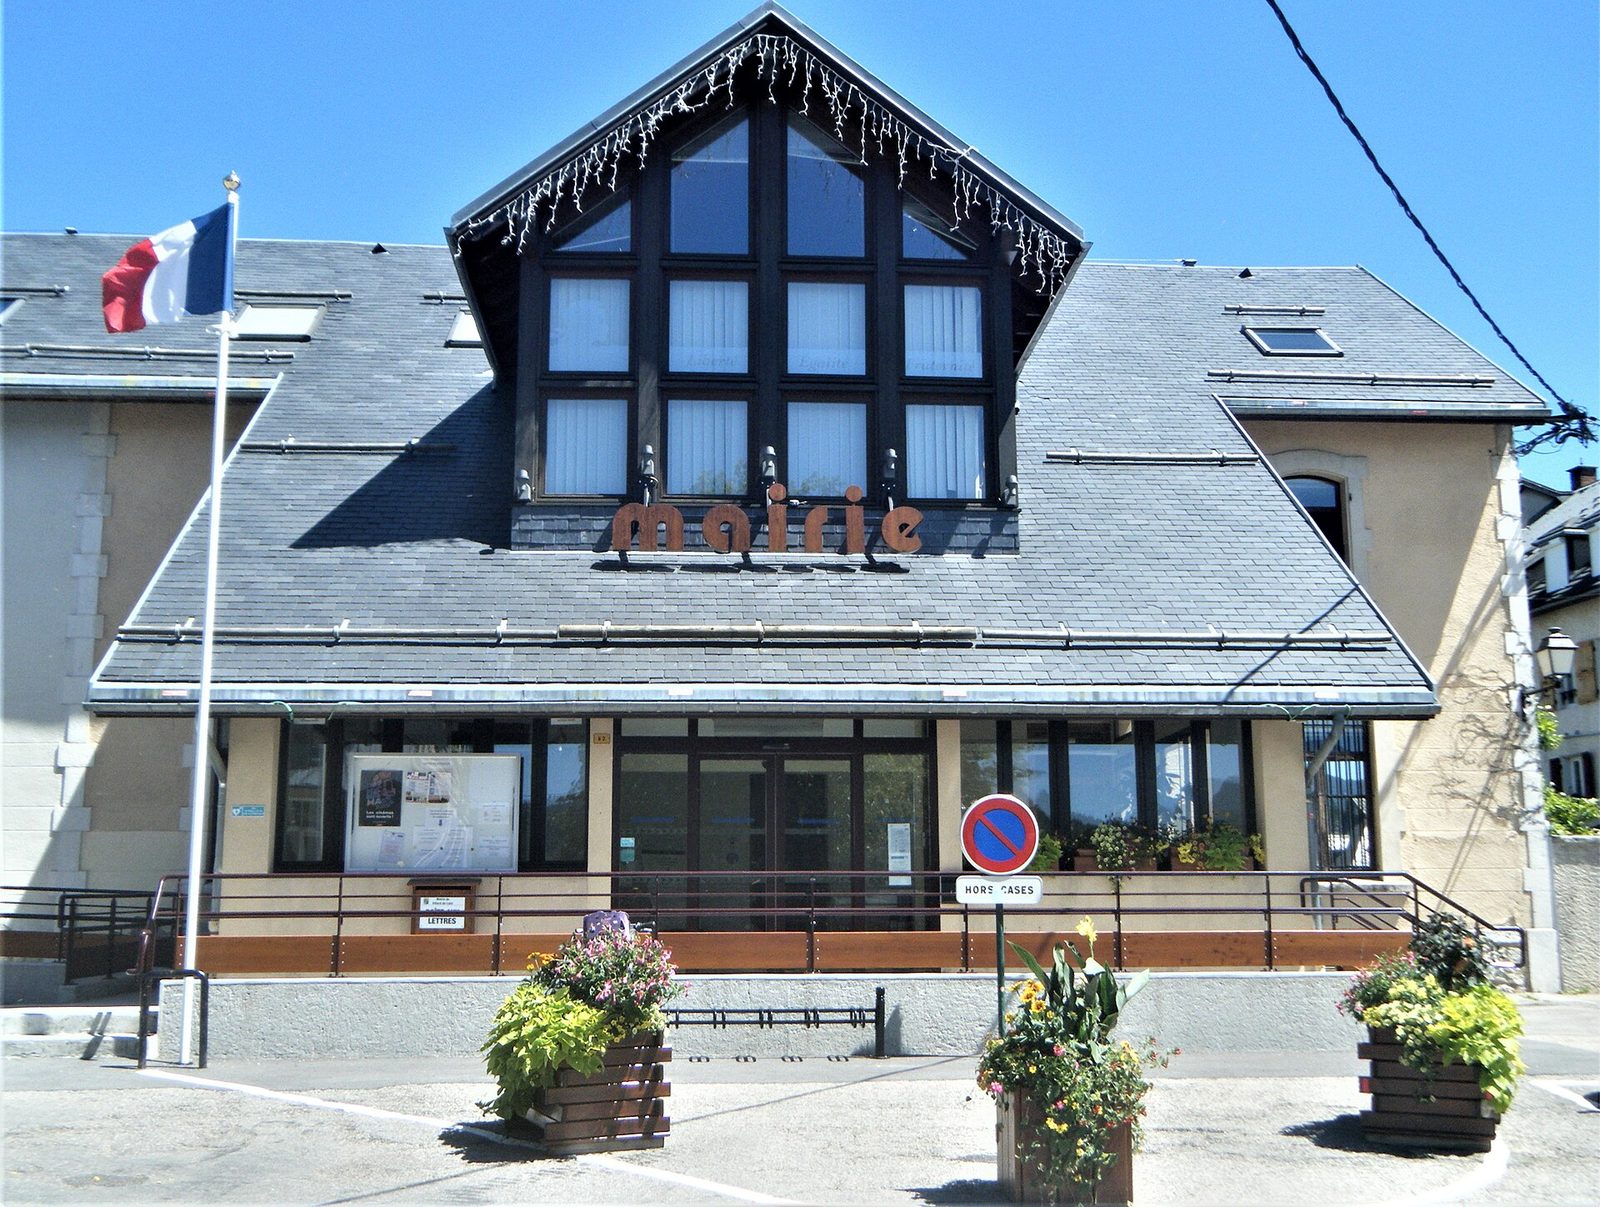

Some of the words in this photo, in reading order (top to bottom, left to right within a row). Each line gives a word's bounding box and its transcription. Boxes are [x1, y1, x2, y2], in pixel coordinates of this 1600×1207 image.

[612, 483, 924, 554] mairie
[965, 885, 994, 894] HORS
[428, 917, 457, 925] LETTRES
